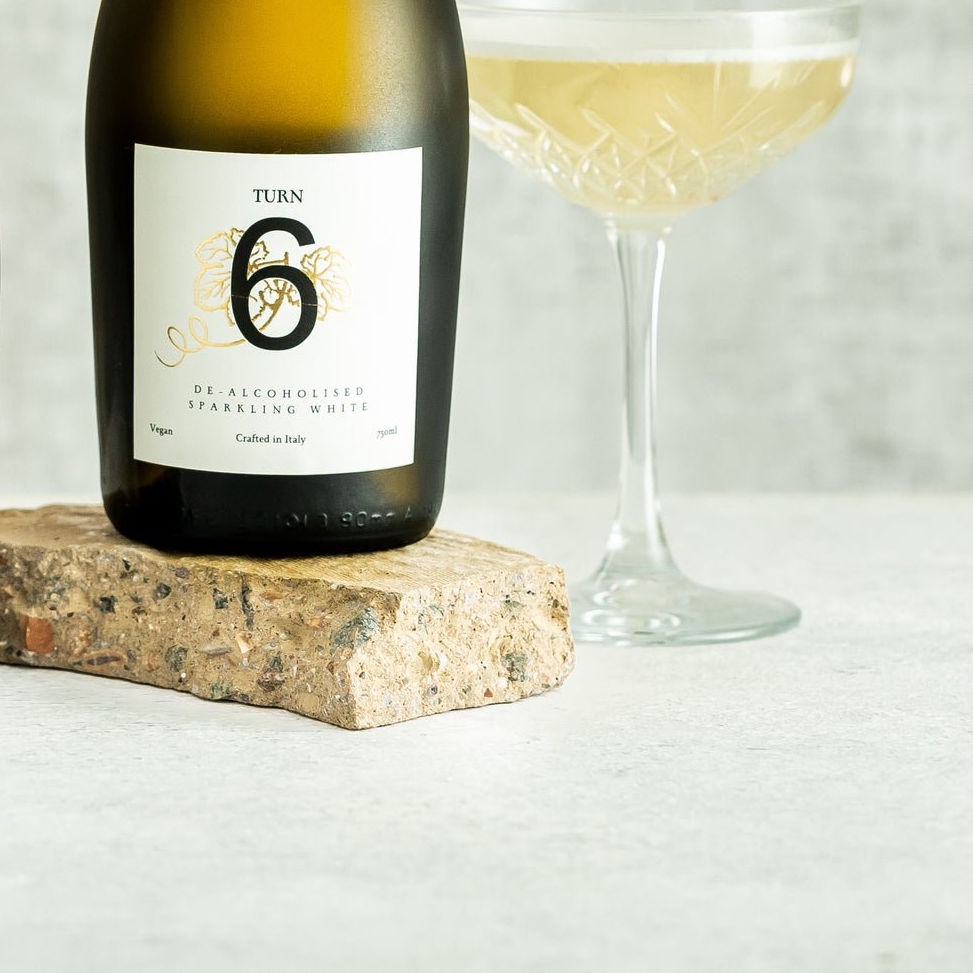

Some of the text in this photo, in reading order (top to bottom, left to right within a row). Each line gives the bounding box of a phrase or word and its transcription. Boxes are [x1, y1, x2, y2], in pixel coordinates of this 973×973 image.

[253, 188, 304, 204] TURN
[231, 216, 318, 351] 6
[193, 384, 364, 399] DE-ALCOHOLISED
[188, 399, 368, 415] SPARKLING WHITE
[149, 423, 174, 437] Vegan
[376, 425, 398, 440] 750ml
[235, 433, 307, 447] Crafted in Italy
